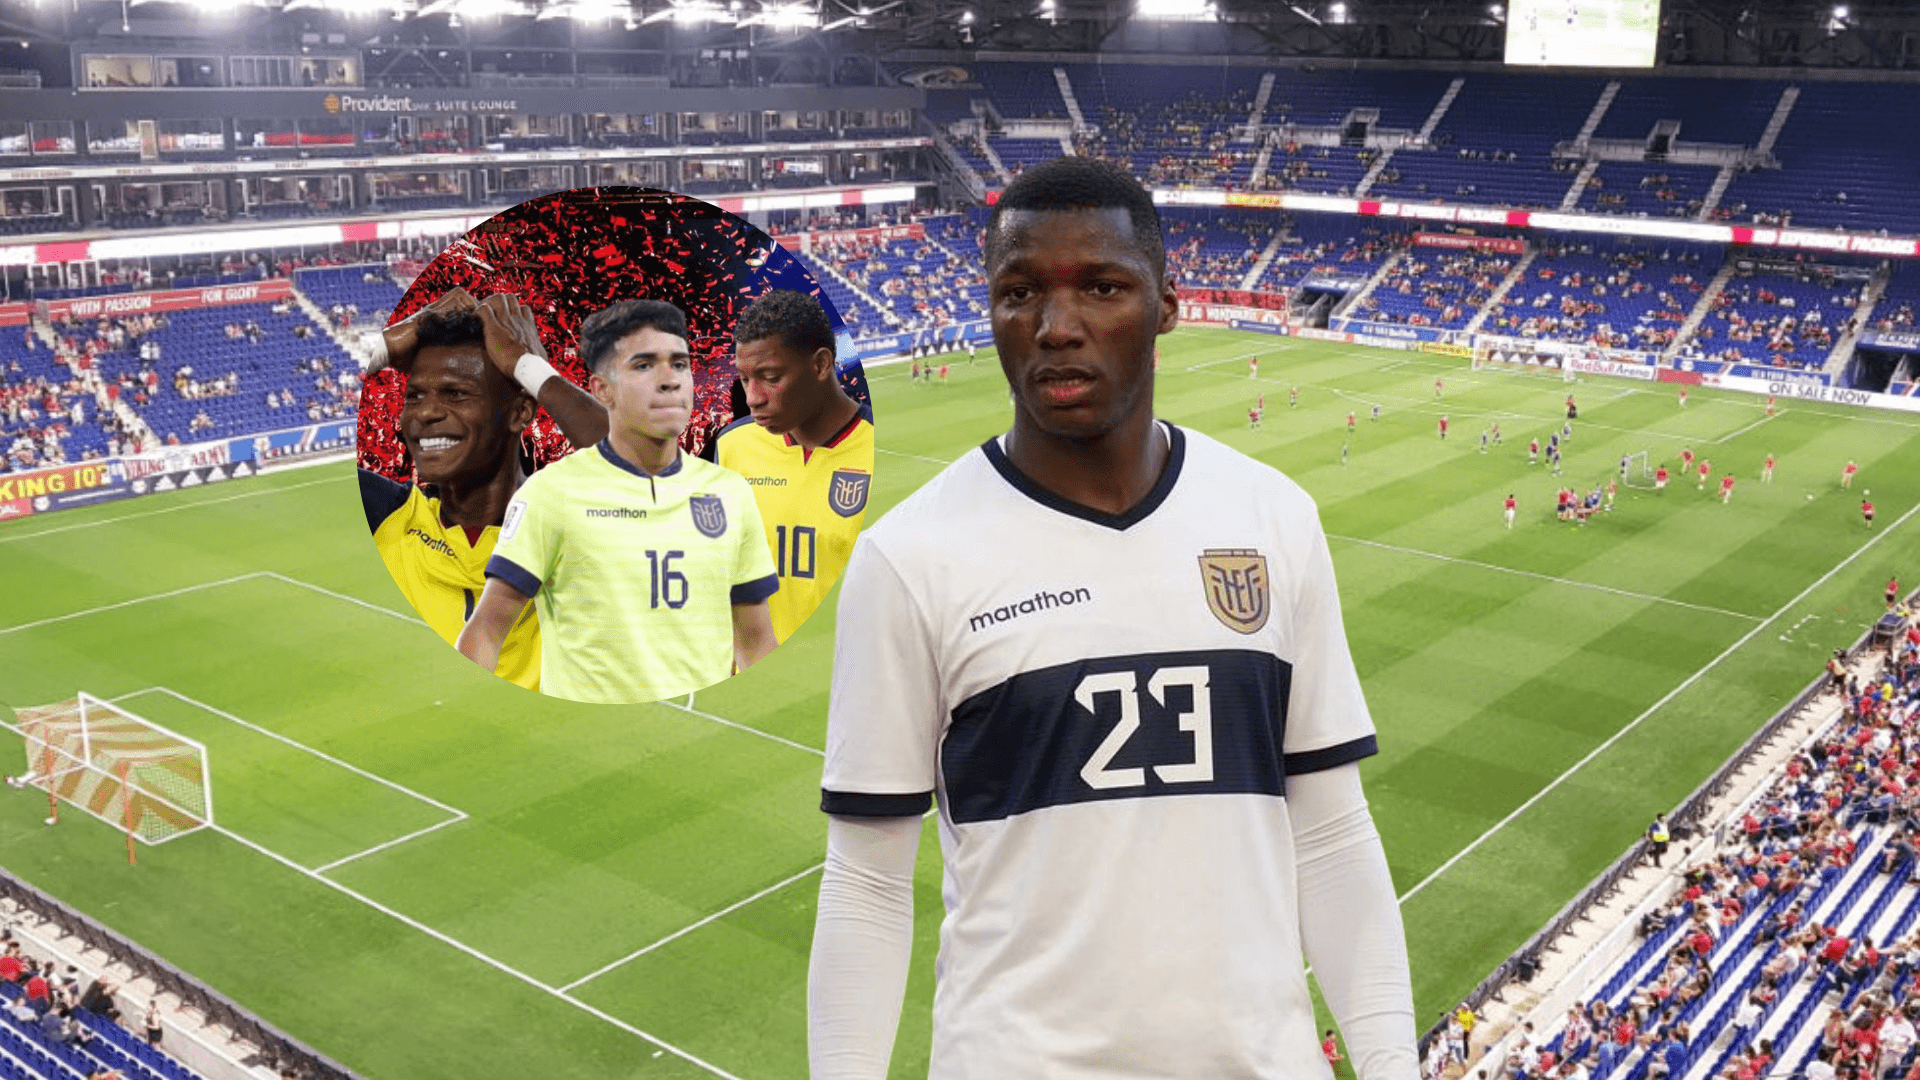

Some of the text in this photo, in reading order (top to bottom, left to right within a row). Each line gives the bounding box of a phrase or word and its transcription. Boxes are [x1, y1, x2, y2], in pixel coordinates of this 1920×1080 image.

[342, 94, 412, 112] Provident
[436, 100, 468, 111] SUITE
[471, 100, 517, 110] LOUNGE
[71, 296, 151, 314] WITH PASSION
[201, 287, 259, 303] FOR GLORY
[1617, 364, 1650, 377] Arena
[1769, 382, 1871, 405] ON SALE NOW
[0, 473, 66, 500] KING
[744, 476, 787, 486] arathon
[586, 507, 647, 519] marathon
[776, 525, 816, 579] 10
[645, 550, 689, 609] 16
[969, 587, 1092, 632] marathon
[1074, 665, 1214, 790] 23
